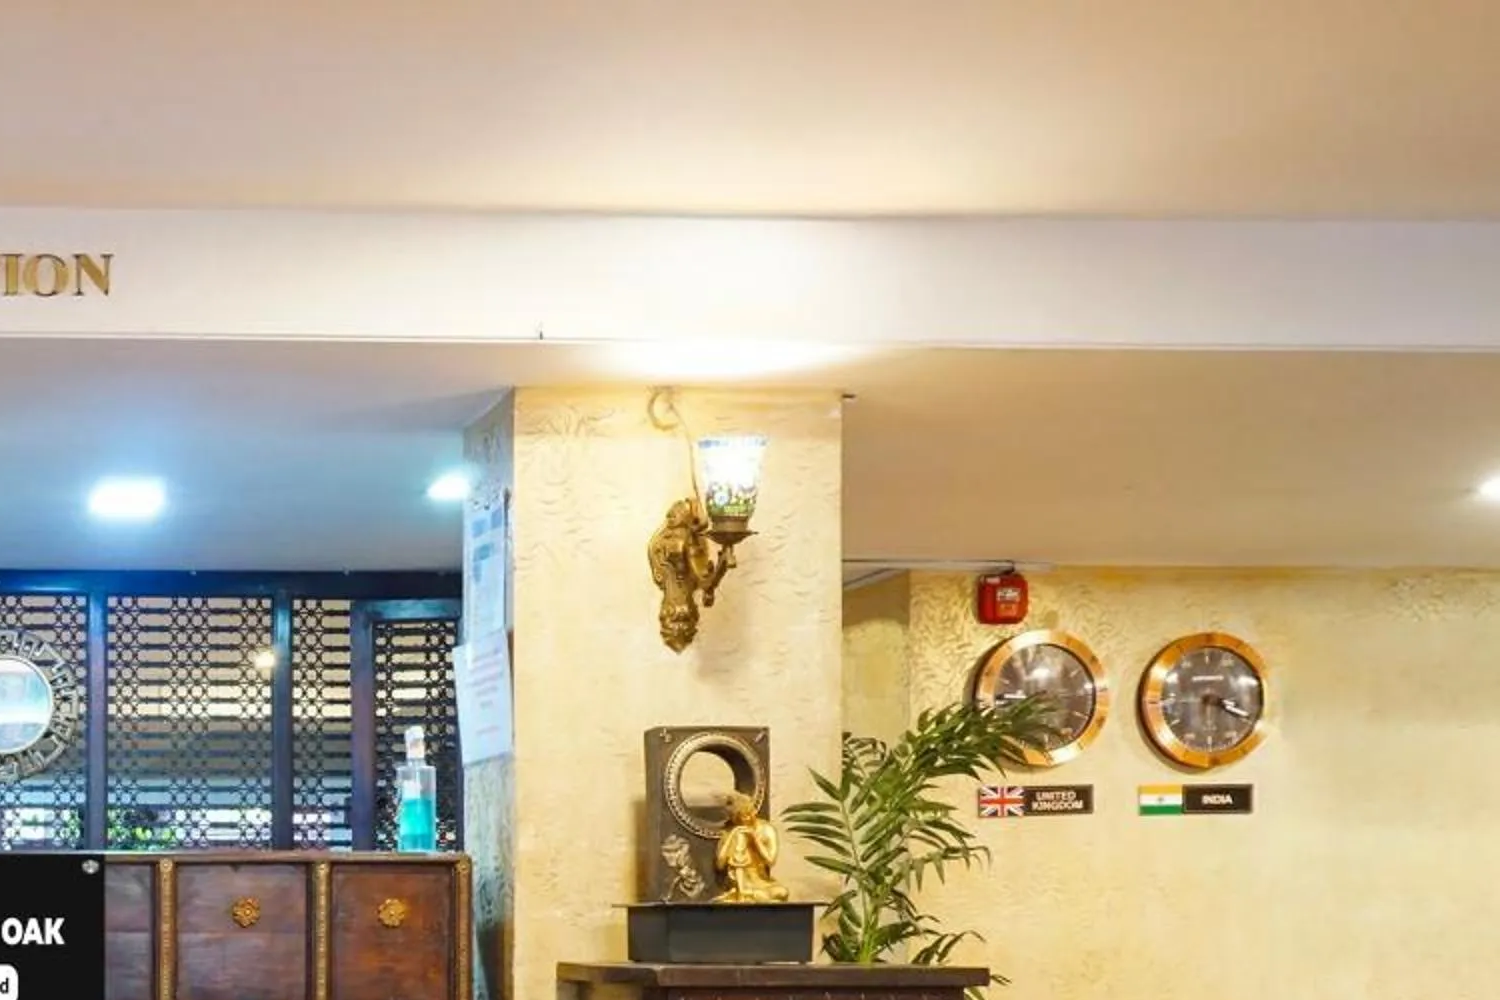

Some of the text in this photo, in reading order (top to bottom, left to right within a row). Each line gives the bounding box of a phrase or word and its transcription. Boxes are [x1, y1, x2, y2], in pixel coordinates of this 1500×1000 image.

[1035, 791, 1077, 801] UNITED
[1202, 794, 1233, 805] INDIA
[1031, 800, 1083, 811] KINGDOM
[1, 917, 65, 946] OAK
